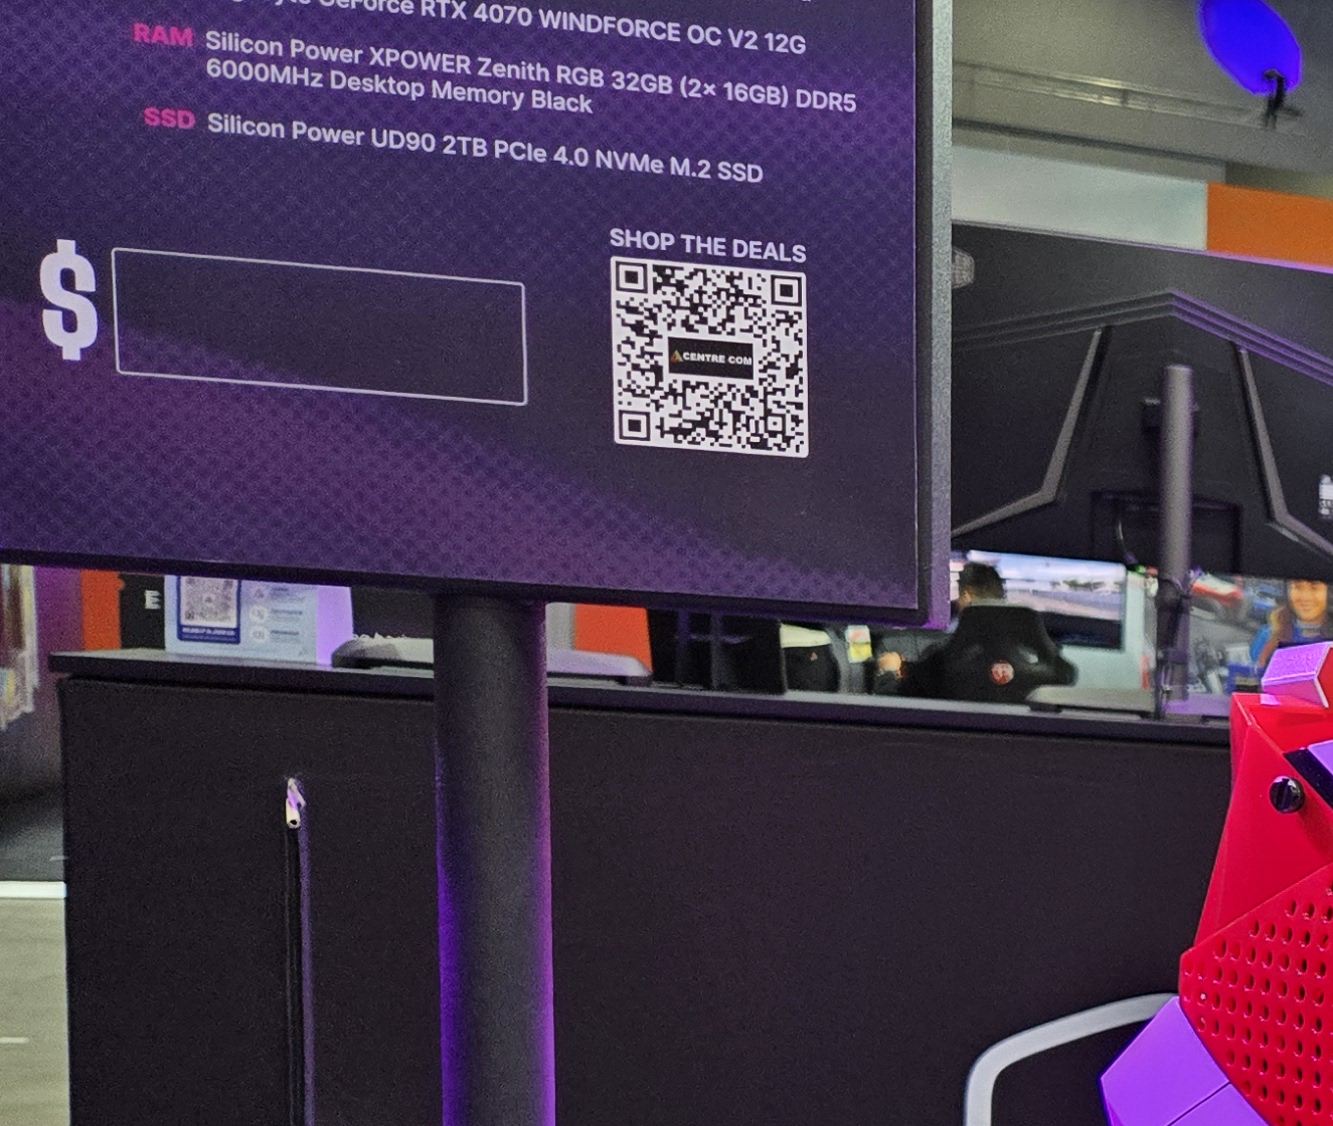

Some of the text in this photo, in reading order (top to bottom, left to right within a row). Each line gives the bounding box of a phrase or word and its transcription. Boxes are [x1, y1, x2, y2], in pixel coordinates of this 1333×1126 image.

[420, 0, 467, 20] RTX
[473, 2, 533, 27] 4070
[538, 8, 681, 43] WINDFORCE
[686, 24, 722, 47] OC
[727, 27, 759, 50] V2
[763, 32, 807, 55] 12G
[133, 22, 193, 47] RAM
[205, 30, 283, 57] Silicon
[289, 38, 364, 65] Power
[369, 47, 472, 76] XPOWER
[477, 56, 550, 83] Zenith
[556, 64, 605, 88] RGB
[611, 70, 674, 95] 32GB
[723, 81, 789, 108] 16GB)
[796, 88, 857, 113] DDR5
[205, 58, 593, 114] 6000MHz Desktop Memory Black
[143, 107, 764, 183] SSD Silicon Power UD90 2TB PCIe 4.0 NVMe M.2 SSD
[609, 227, 807, 264] SHOP THE DEALS
[40, 239, 97, 361] $
[683, 351, 752, 365] CENTRE COM
